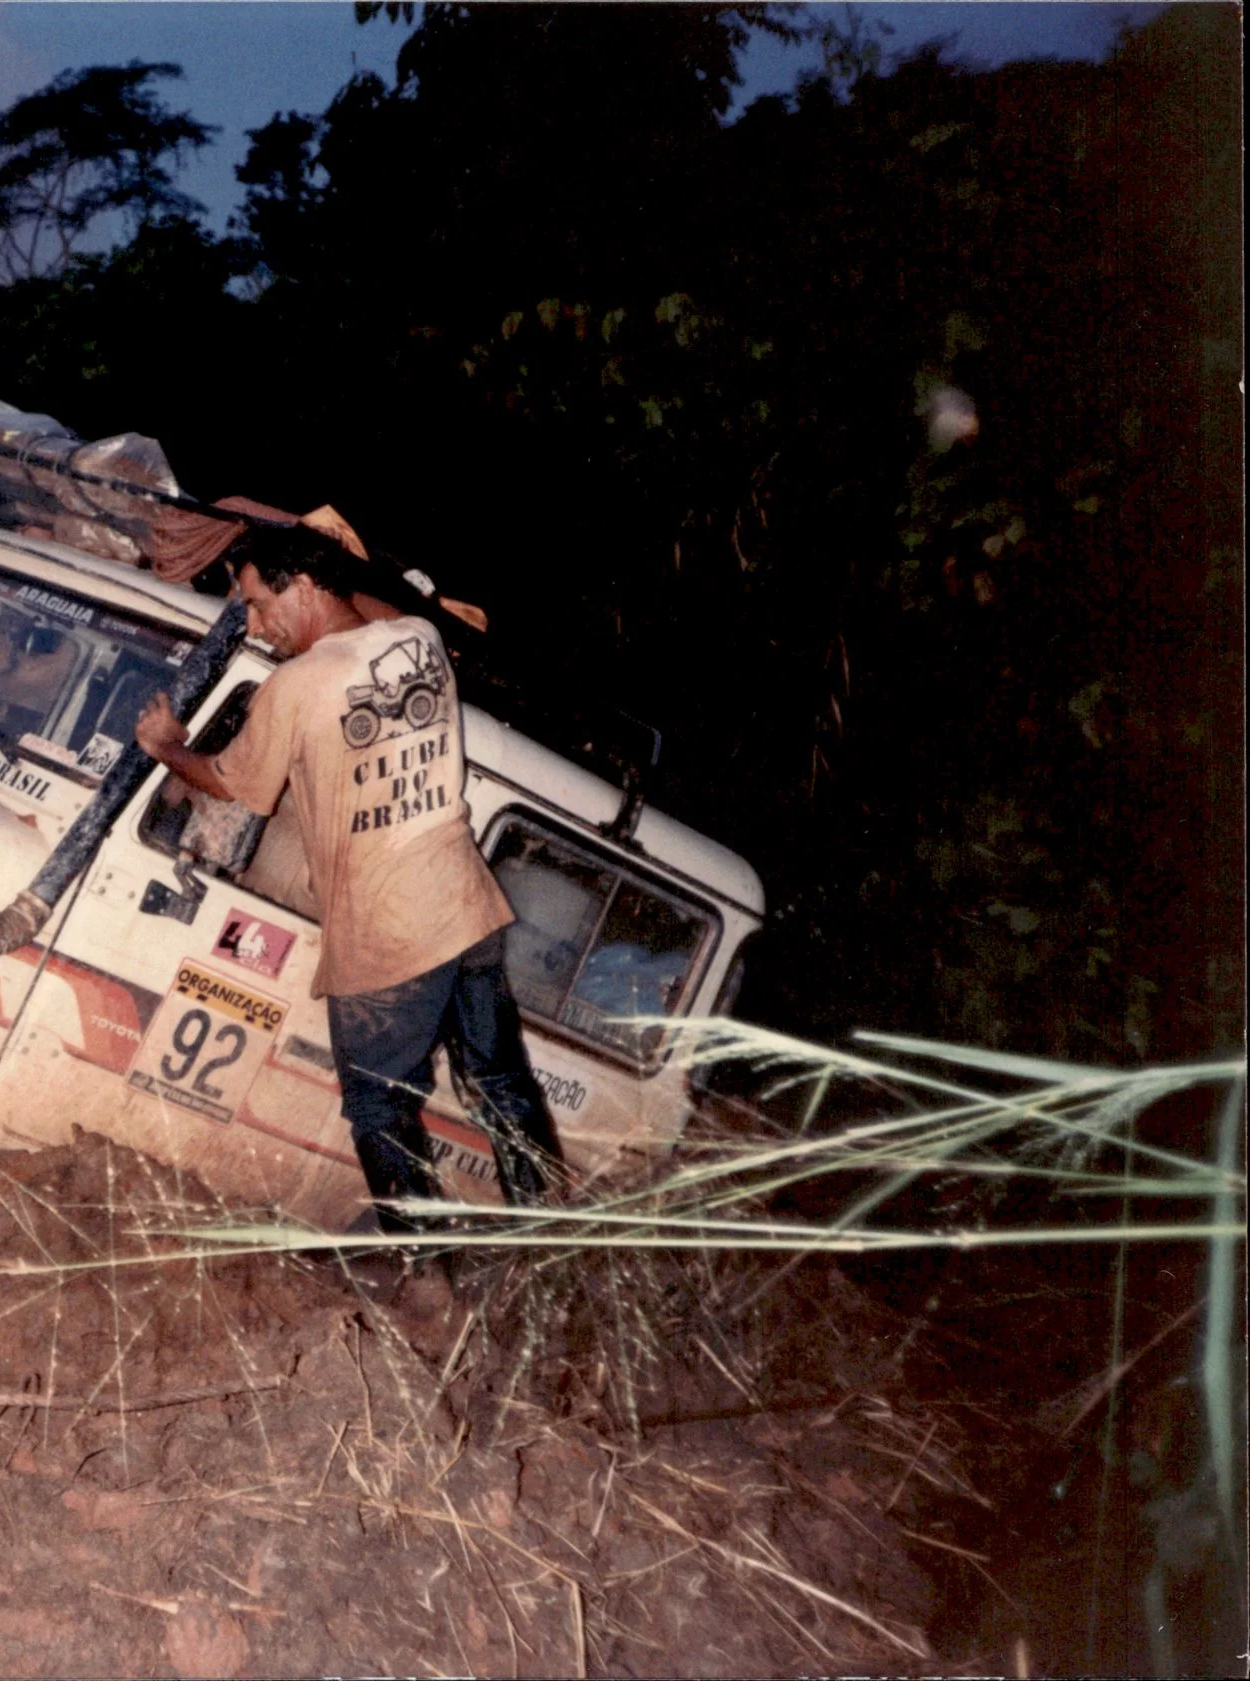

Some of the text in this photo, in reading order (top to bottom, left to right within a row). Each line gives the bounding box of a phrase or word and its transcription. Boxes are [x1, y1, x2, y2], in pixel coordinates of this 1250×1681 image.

[14, 585, 94, 623] ARAGUAIA
[353, 732, 449, 786] CLUBE
[391, 769, 428, 801] DO
[351, 784, 452, 833] BRASIL
[178, 969, 282, 1025] ORGANIZAÇÃO
[90, 1014, 143, 1043] TOYOTA
[160, 1008, 247, 1100] 92
[456, 1150, 498, 1180] CLU
